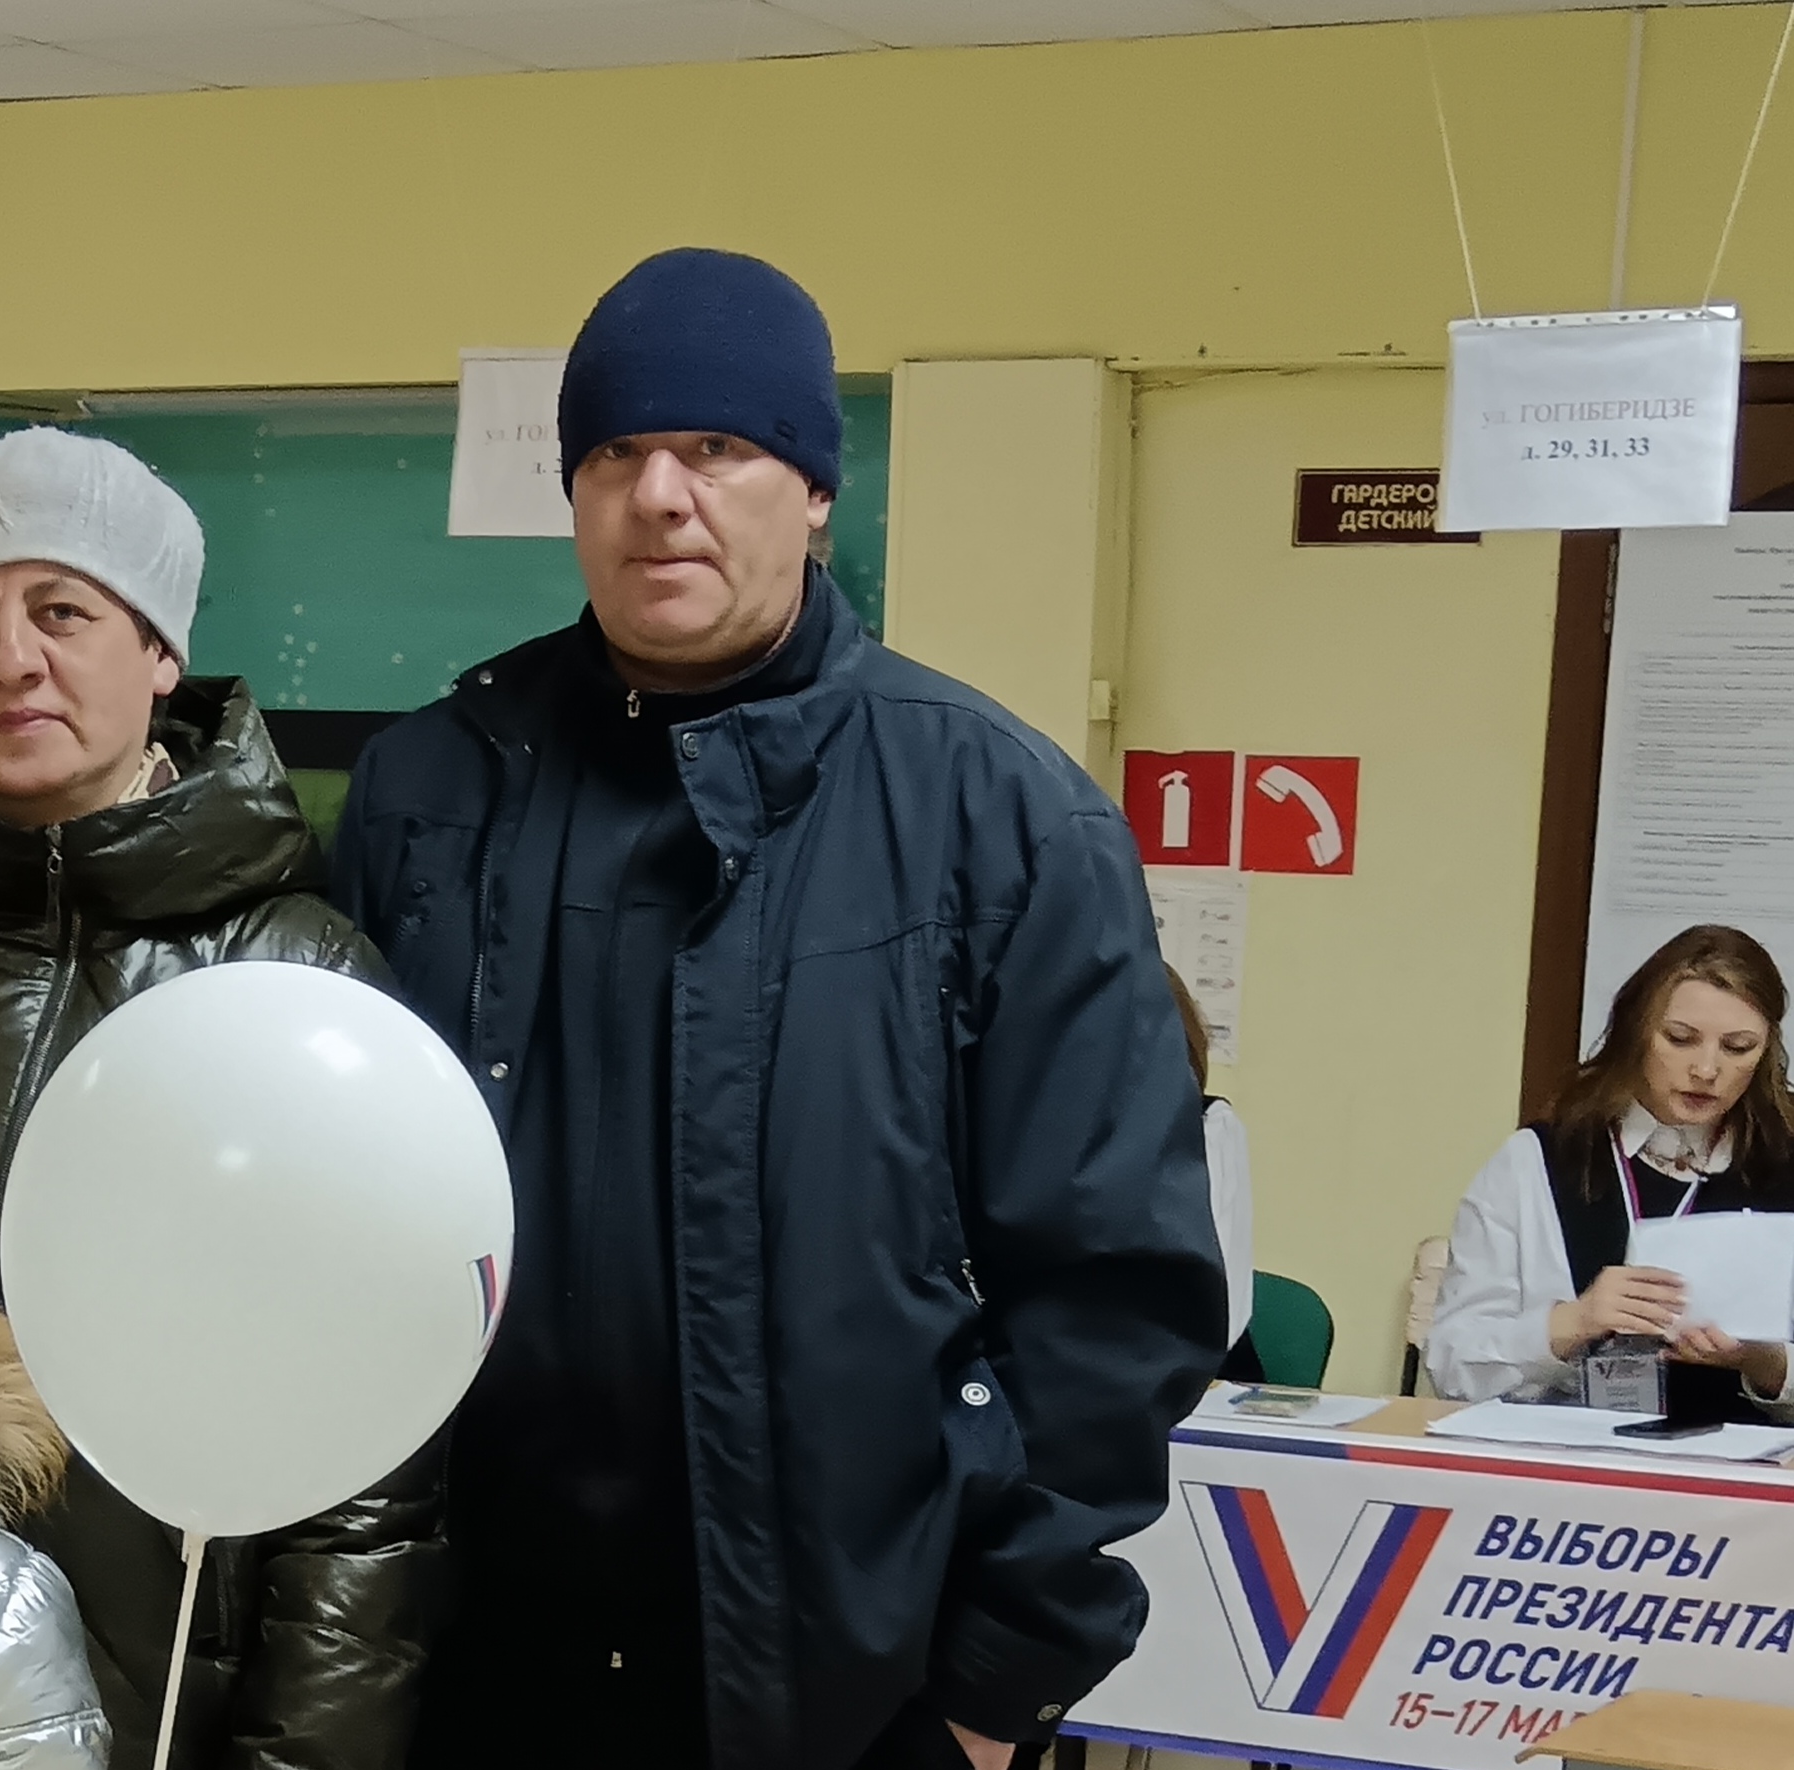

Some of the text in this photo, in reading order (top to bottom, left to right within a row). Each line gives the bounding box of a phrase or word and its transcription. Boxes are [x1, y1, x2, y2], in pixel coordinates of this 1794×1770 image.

[1520, 398, 1697, 423] ГОГИБЕРИДЗЕ
[1548, 440, 1579, 460] 29,
[1585, 438, 1617, 459] 31,
[1624, 437, 1650, 457] 33
[1331, 484, 1437, 507] ГАРДЕРО
[1474, 1514, 1730, 1580] ВЫБОРЫ
[1443, 1575, 1794, 1653] ПРЕЗИДЕНТА
[1412, 1633, 1639, 1699] РОССИИ
